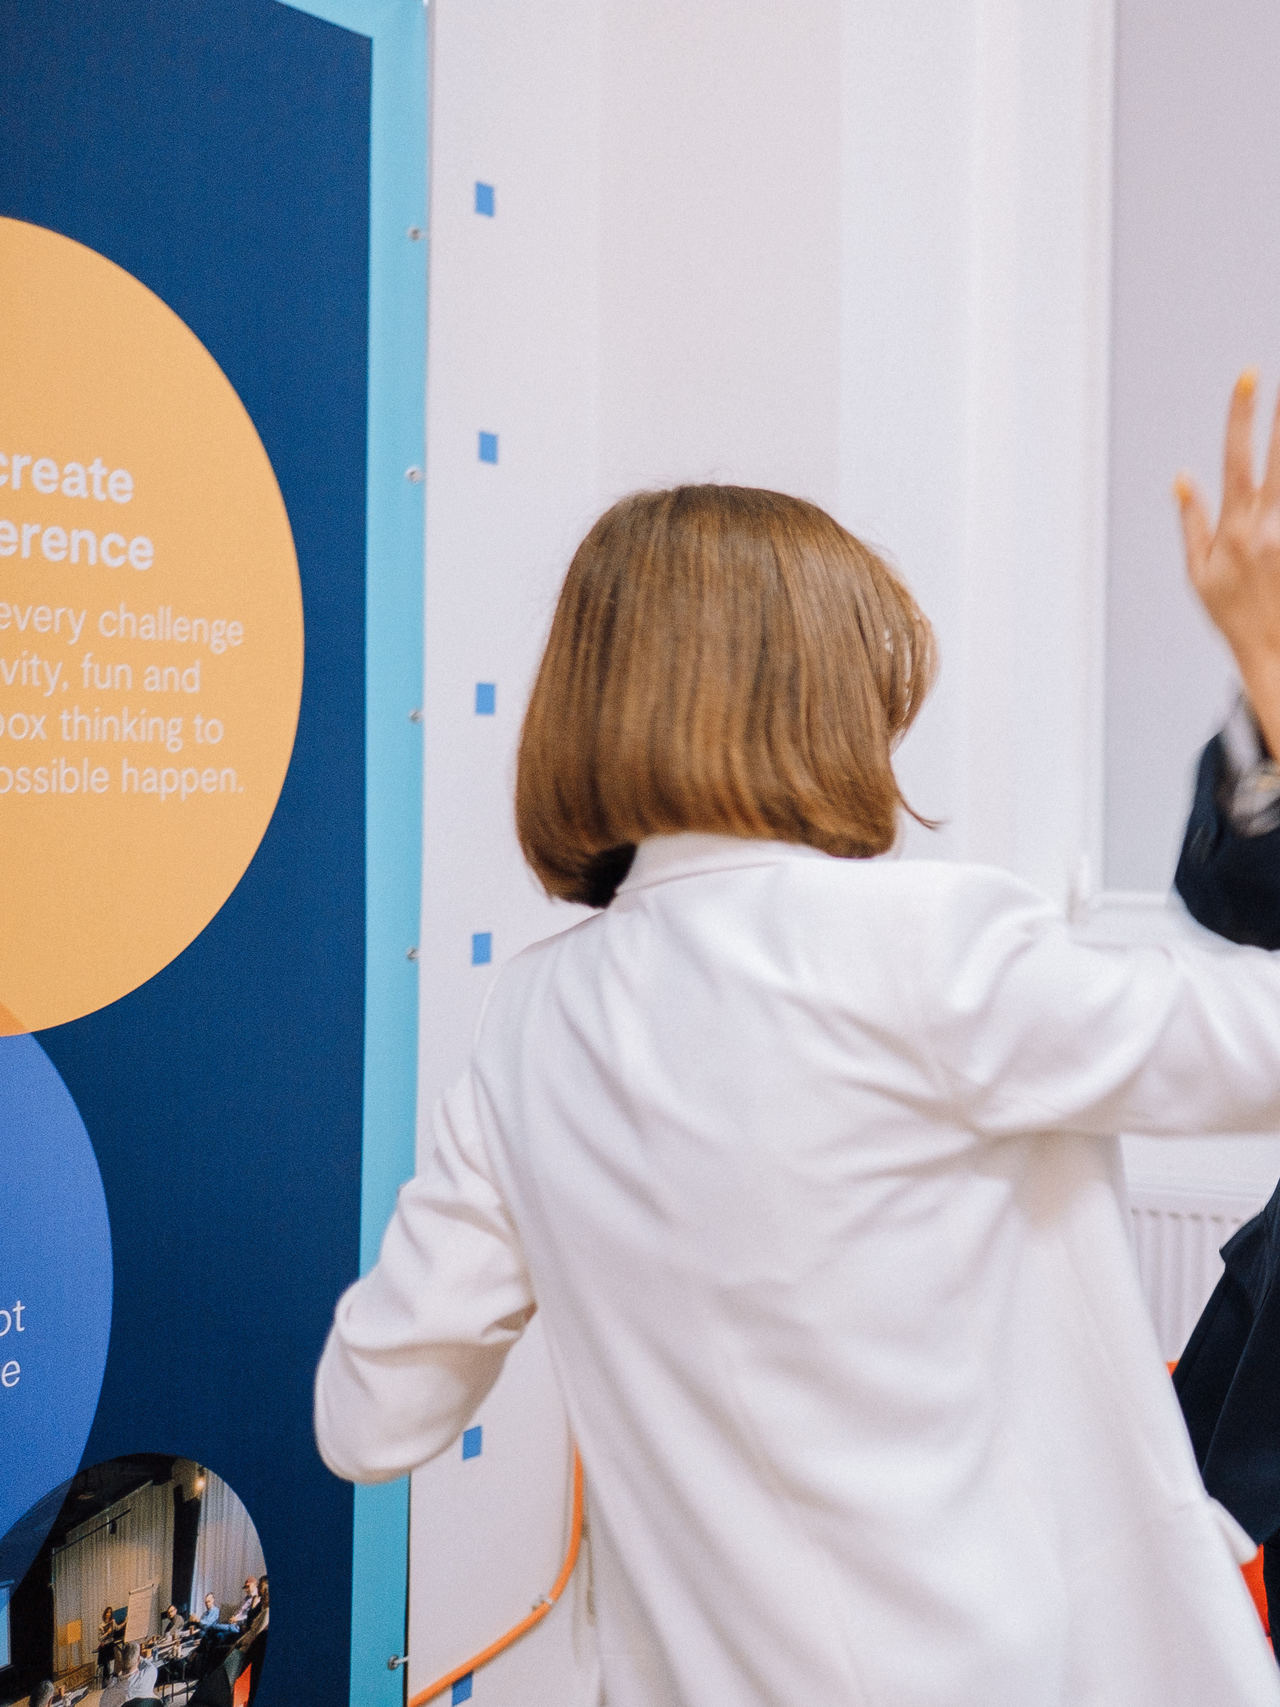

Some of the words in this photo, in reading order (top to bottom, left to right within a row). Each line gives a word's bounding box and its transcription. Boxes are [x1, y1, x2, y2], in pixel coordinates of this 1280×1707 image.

[0, 518, 154, 570] erence
[98, 602, 244, 654] challenge
[0, 650, 69, 696] vity,
[81, 652, 132, 691] fun
[143, 660, 201, 693] and
[0, 712, 47, 741] ox
[60, 705, 183, 753] thinking
[193, 712, 224, 745] to
[121, 758, 244, 801] happen.
